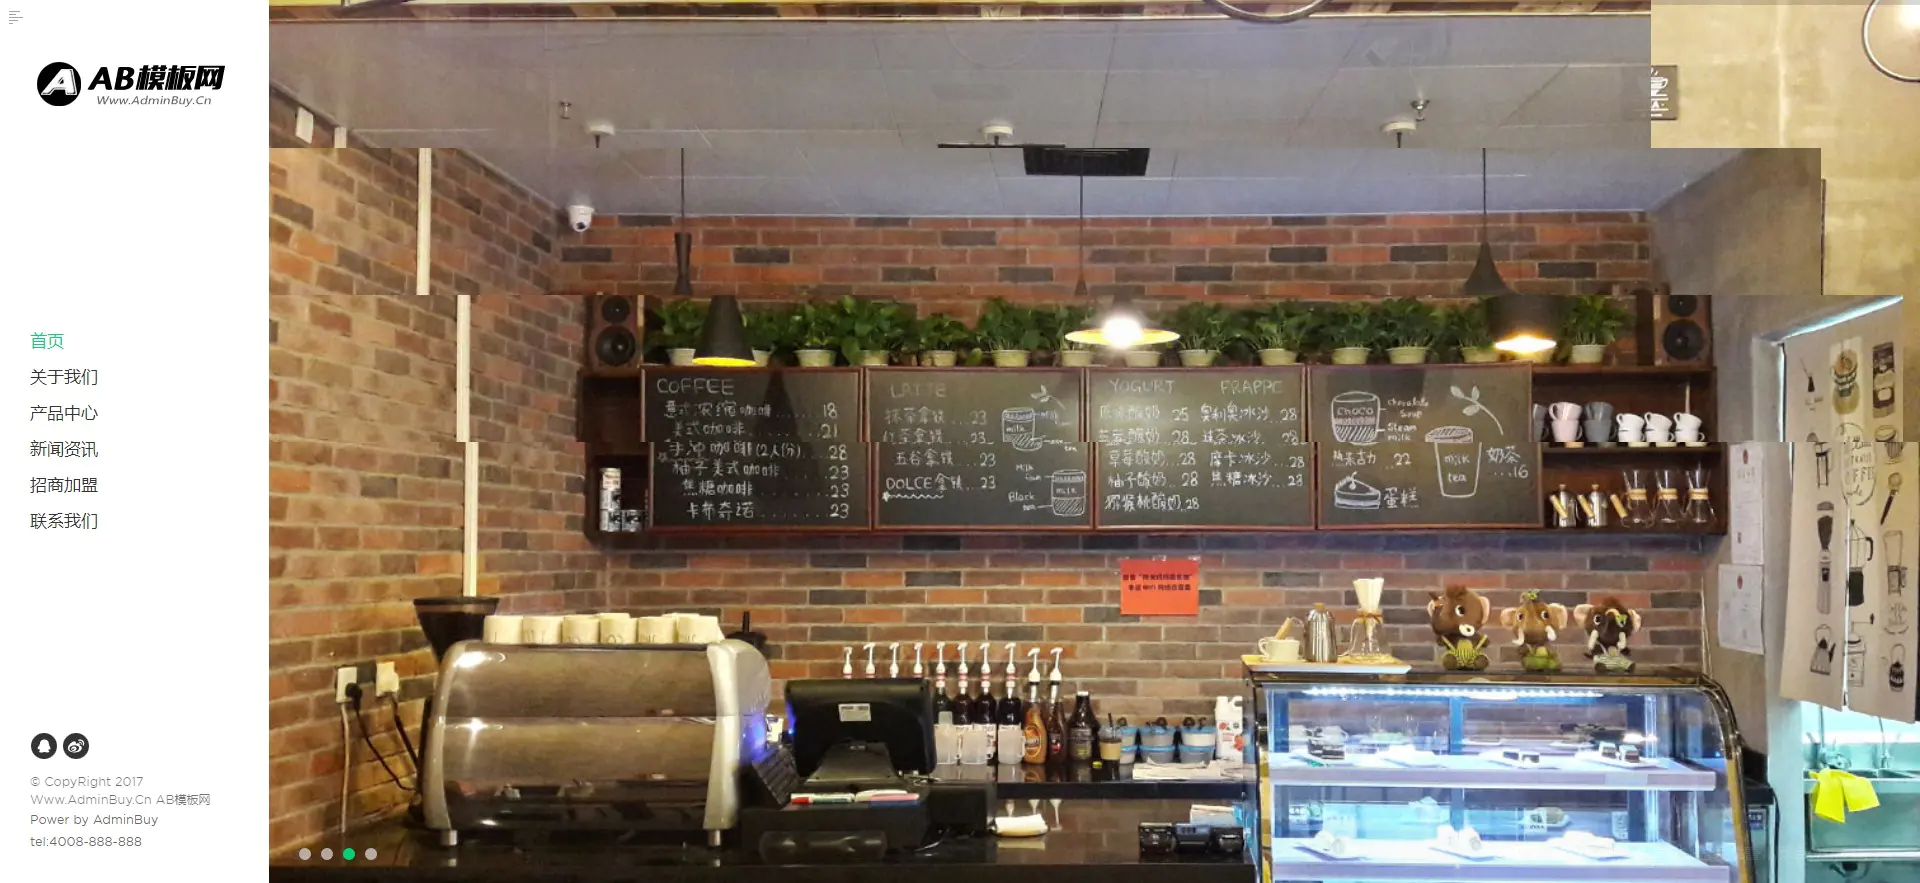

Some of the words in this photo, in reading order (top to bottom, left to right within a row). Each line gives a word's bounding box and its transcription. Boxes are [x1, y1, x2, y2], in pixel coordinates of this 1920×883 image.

[890, 382, 947, 397] LATTE
[1110, 379, 1175, 393] YOGURT
[823, 402, 838, 418] 18
[1172, 407, 1189, 422] 25
[1281, 408, 1298, 421] 28
[969, 410, 987, 425] 23
[672, 420, 746, 437] 美式咖啡
[820, 425, 838, 438] 21
[828, 445, 848, 460] 28
[1179, 451, 1196, 465] 28
[1393, 453, 1412, 466] 22
[1444, 453, 1470, 465] milk
[1486, 446, 1521, 464] 奶茶
[980, 453, 996, 467] 23
[1289, 456, 1305, 469] 28
[830, 465, 850, 480] 23
[1448, 472, 1467, 483] tea
[1513, 465, 1529, 478] 16
[980, 476, 996, 490] 23
[1181, 472, 1199, 487] 28
[1008, 492, 1036, 502] Black
[1186, 498, 1199, 510] 28
[686, 501, 755, 521] 卡布奇诺
[830, 503, 850, 519] 23
